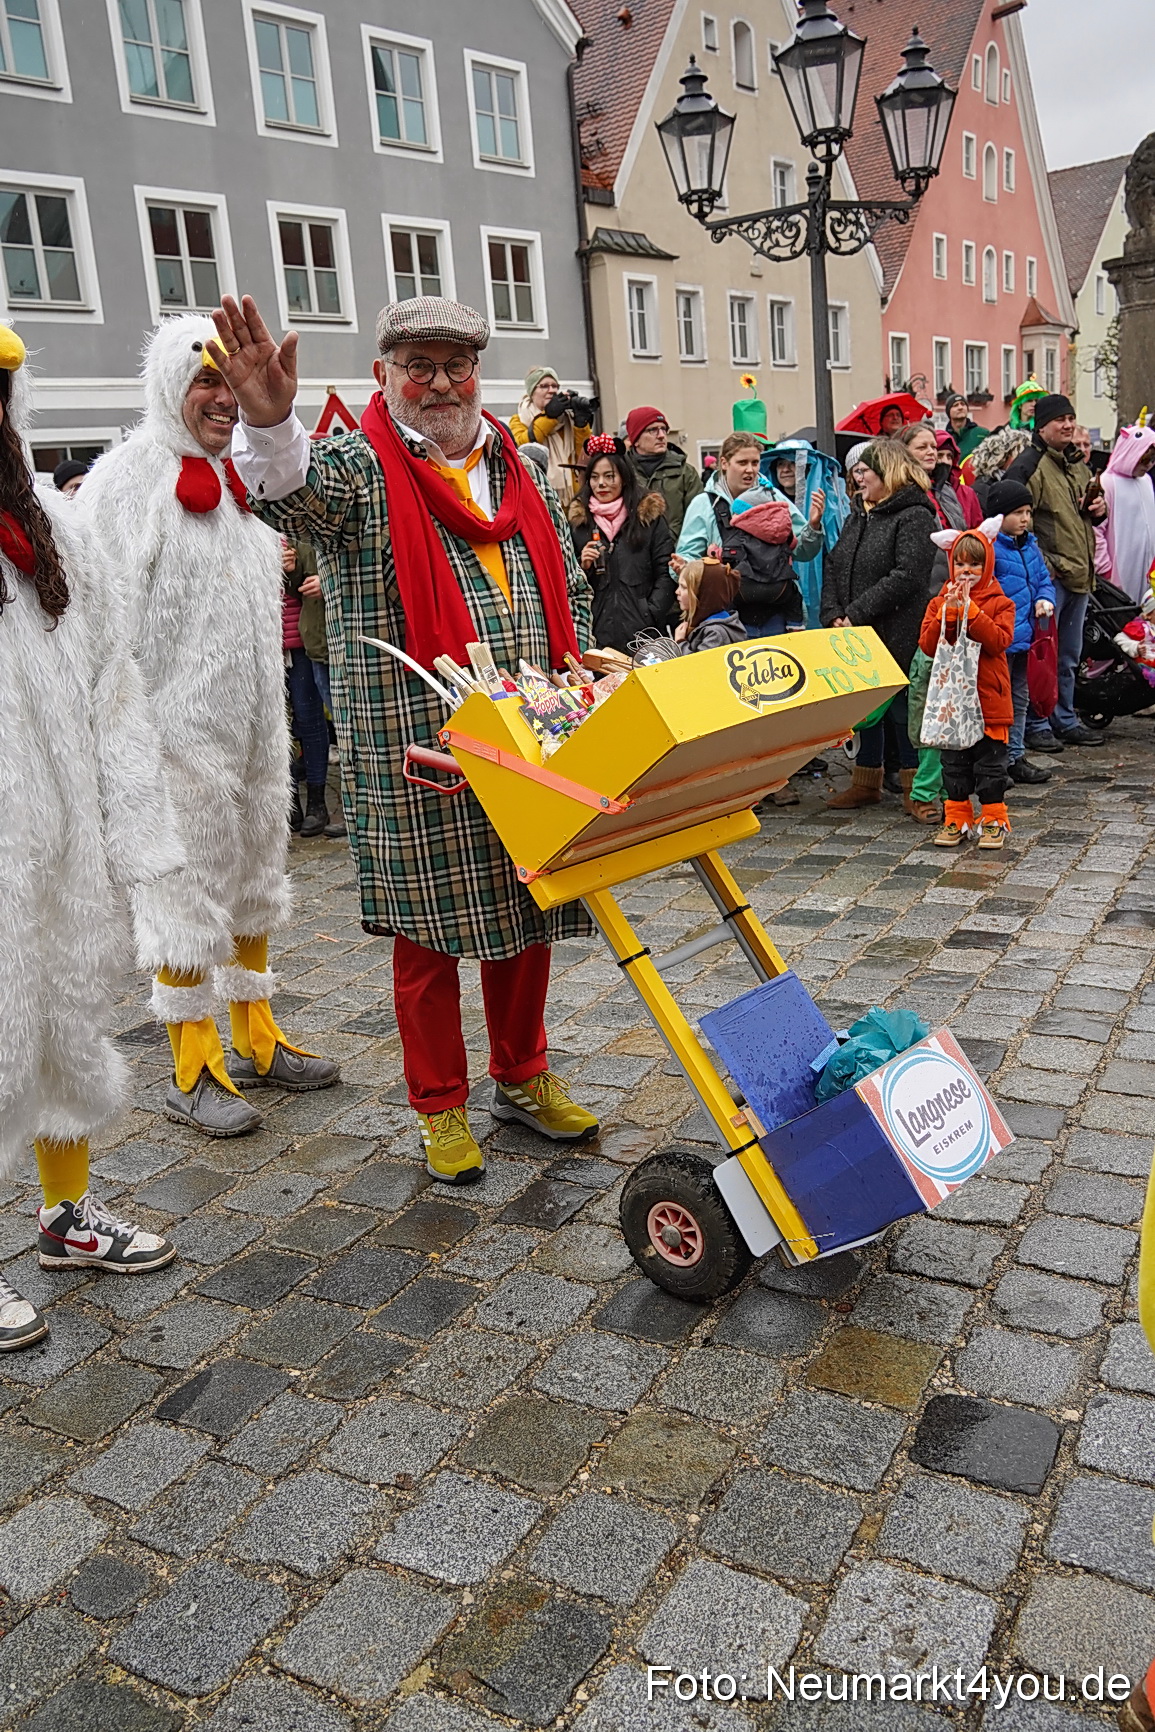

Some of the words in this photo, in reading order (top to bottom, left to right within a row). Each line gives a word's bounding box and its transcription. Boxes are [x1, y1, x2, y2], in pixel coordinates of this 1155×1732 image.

[726, 648, 795, 690] Edeka
[814, 666, 855, 694] TO
[894, 1077, 973, 1149] Langnese
[931, 1119, 975, 1156] EISKREM
